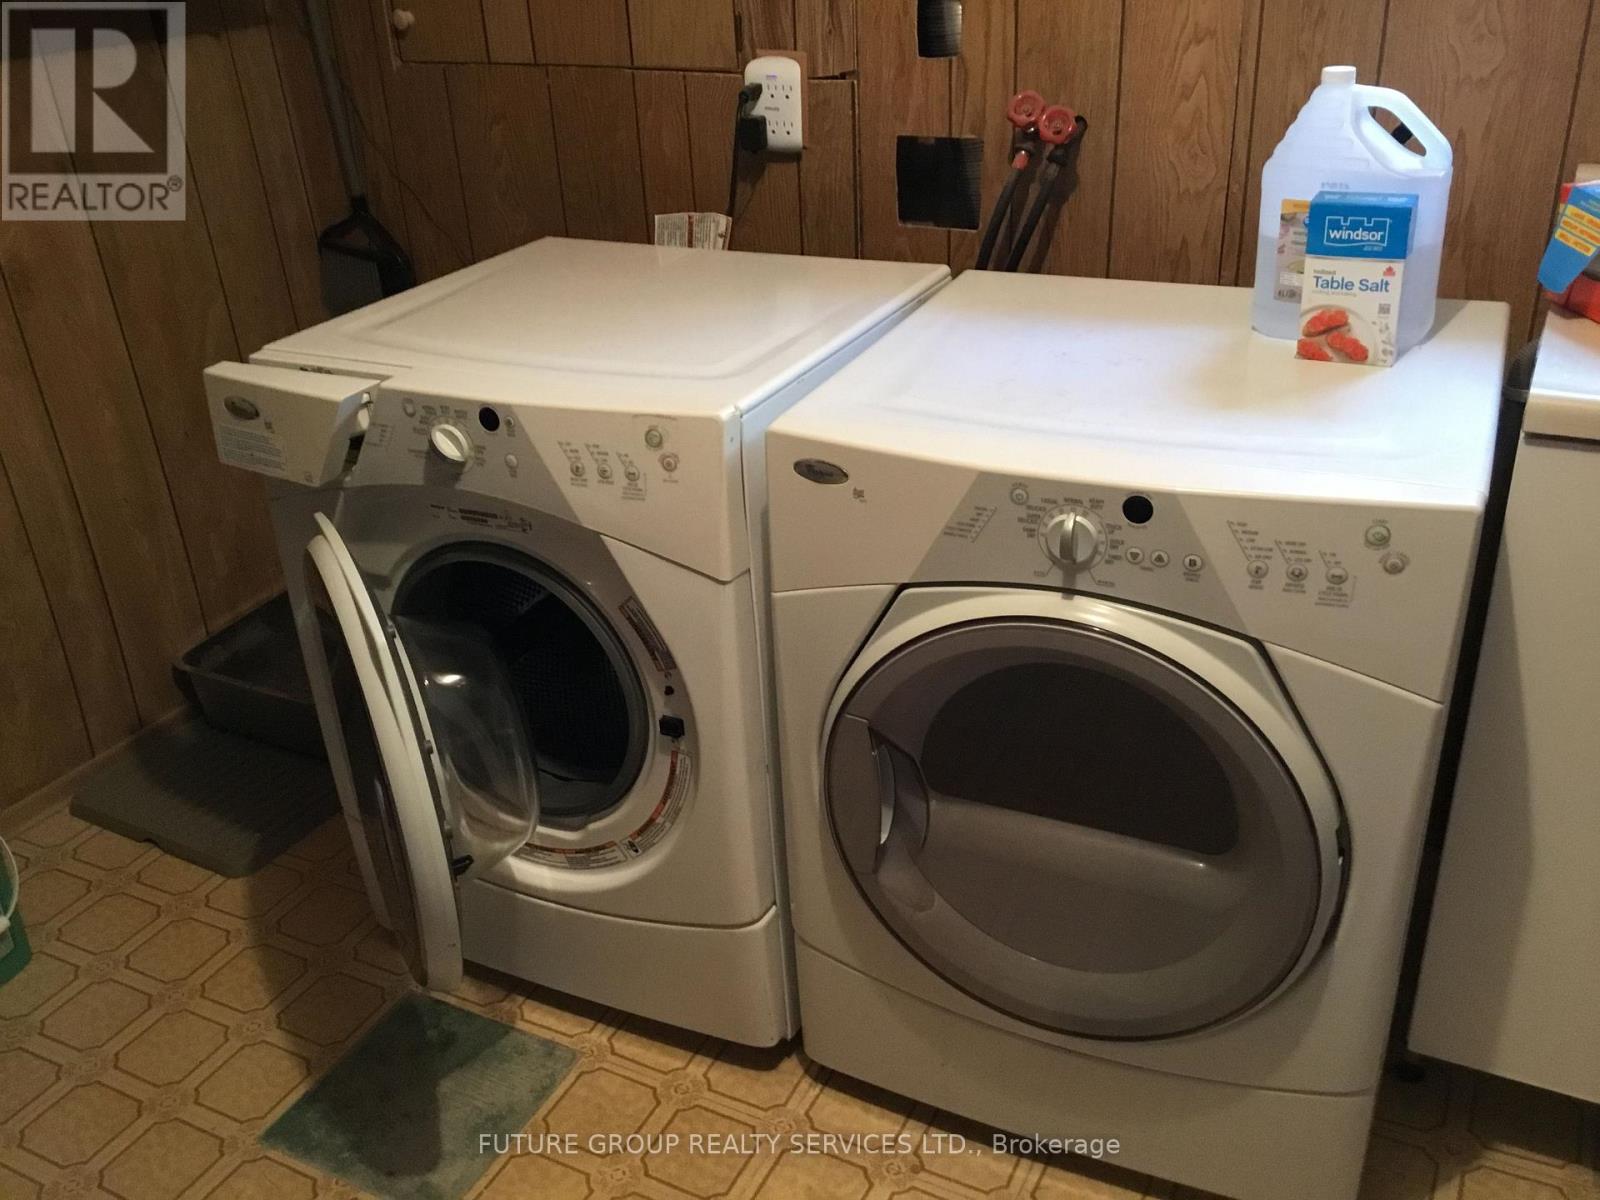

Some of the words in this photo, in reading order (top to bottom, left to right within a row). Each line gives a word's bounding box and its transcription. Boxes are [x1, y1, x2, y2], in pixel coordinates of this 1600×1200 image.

[1328, 226, 1384, 242] windsor
[1312, 275, 1355, 291] Table
[1358, 277, 1391, 293] Salt
